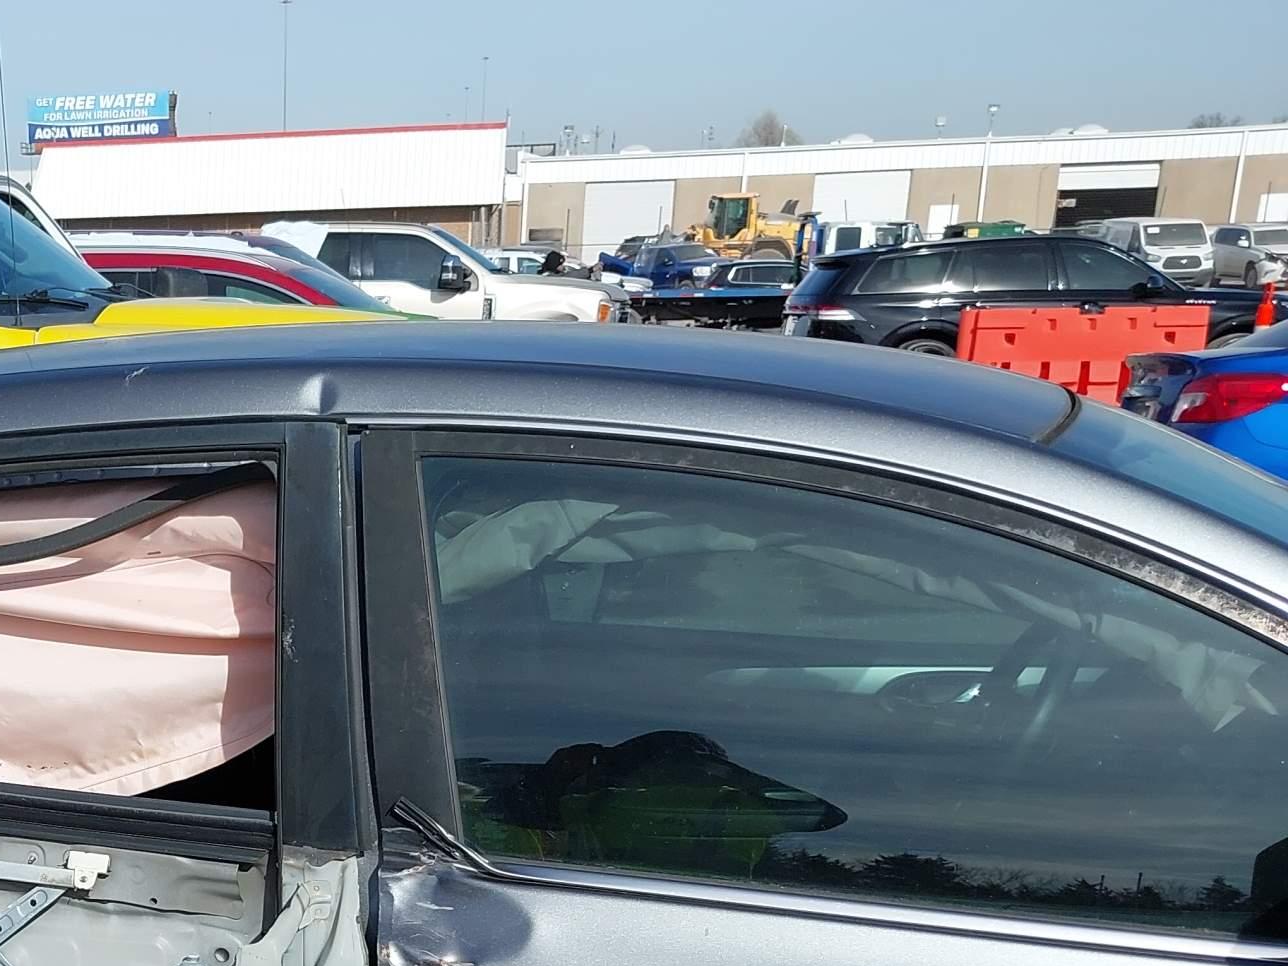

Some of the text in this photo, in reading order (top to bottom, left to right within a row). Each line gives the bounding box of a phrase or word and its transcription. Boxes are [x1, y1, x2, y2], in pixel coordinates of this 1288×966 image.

[55, 96, 95, 110] FREE
[99, 93, 156, 108] WATER
[44, 108, 148, 121] FOR LAWN IRRIGATION
[70, 125, 102, 138] WELL
[103, 124, 159, 136] DRILLING
